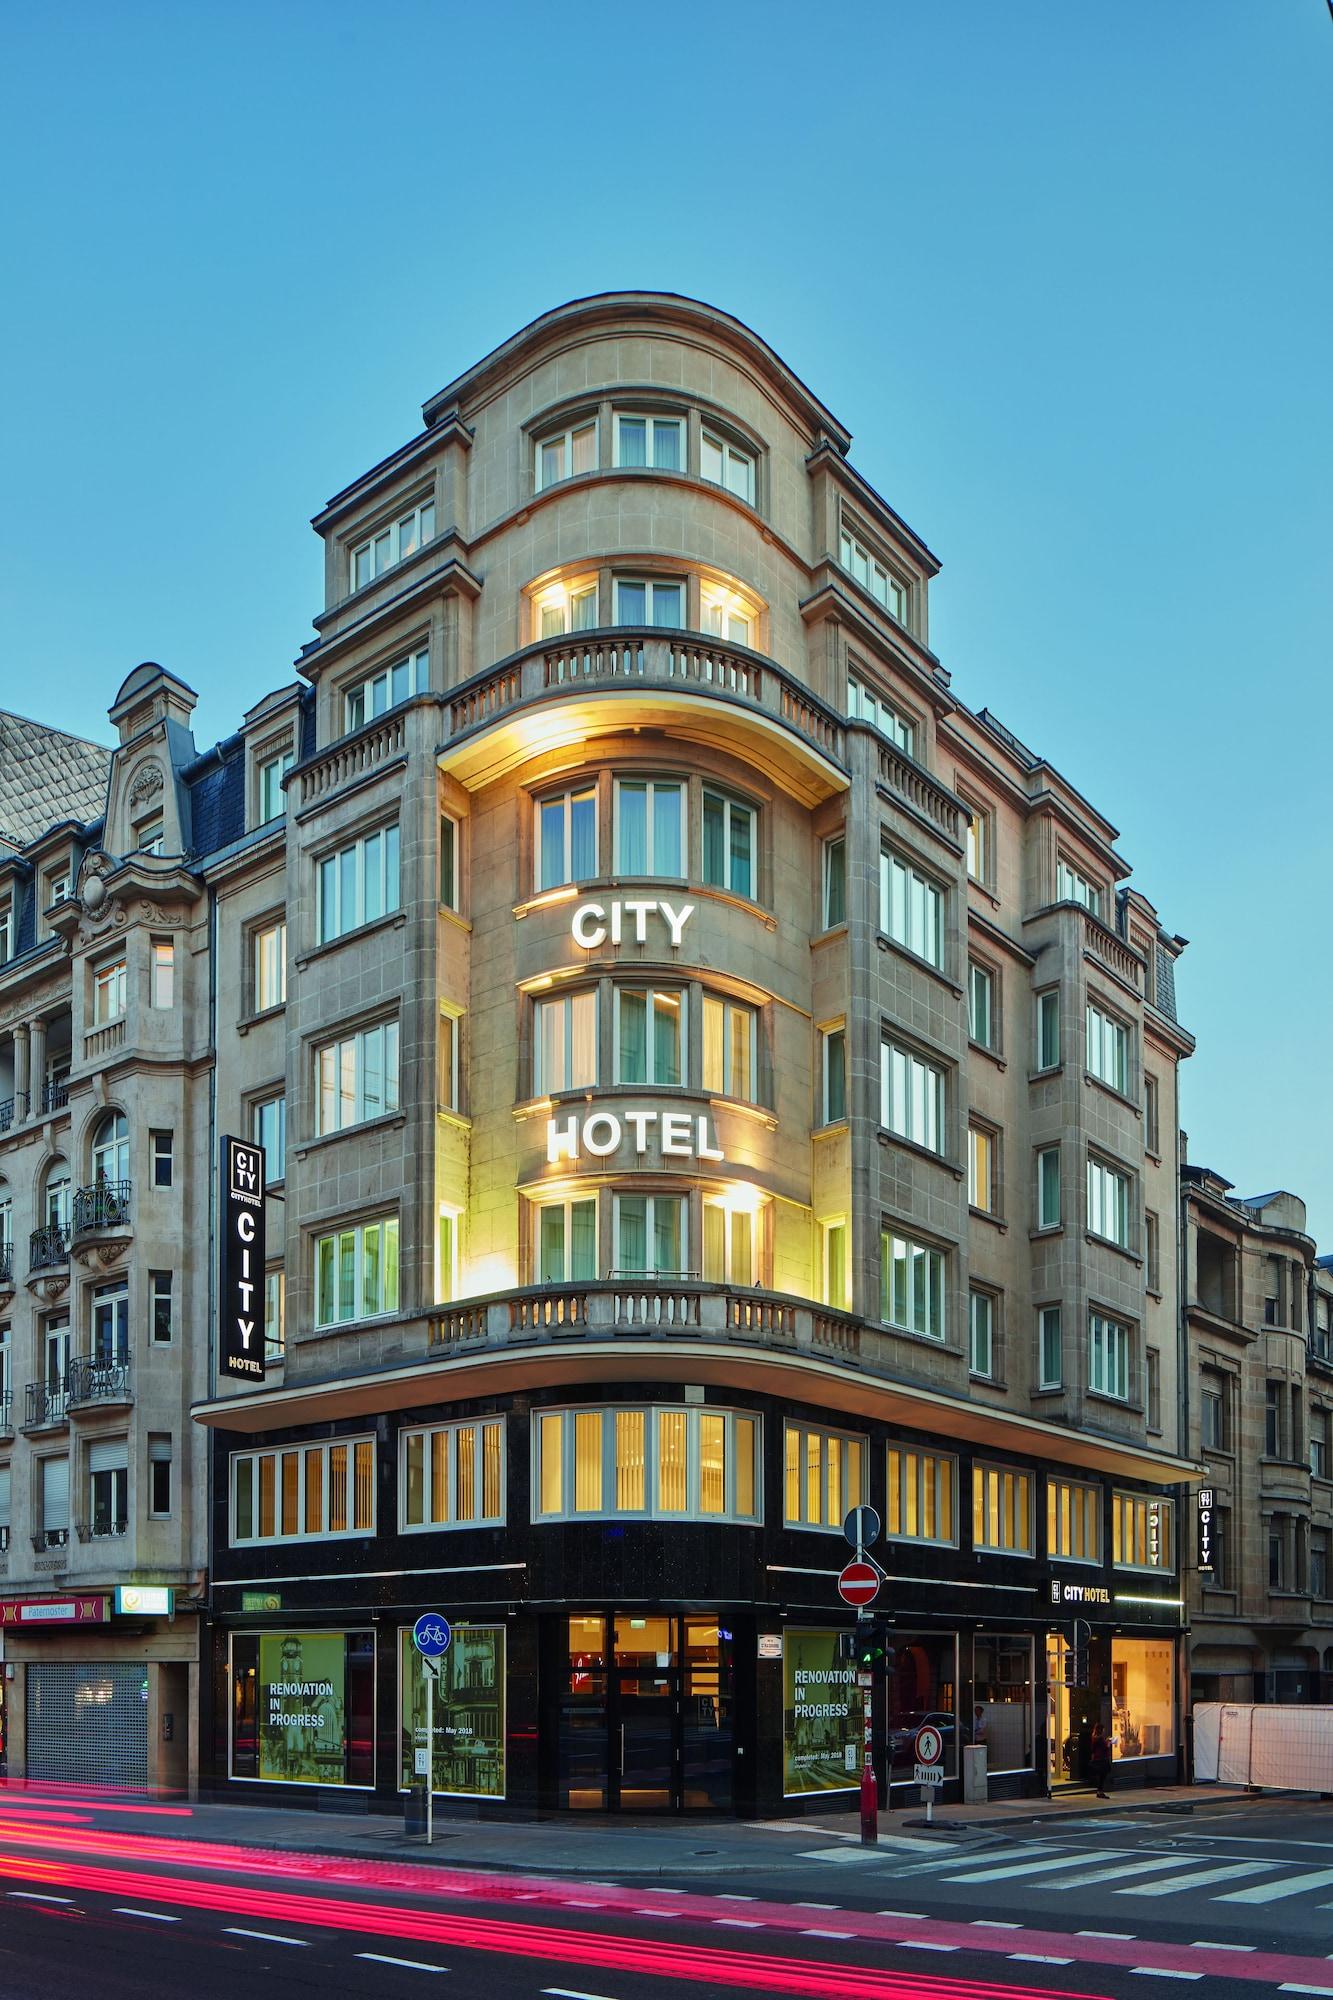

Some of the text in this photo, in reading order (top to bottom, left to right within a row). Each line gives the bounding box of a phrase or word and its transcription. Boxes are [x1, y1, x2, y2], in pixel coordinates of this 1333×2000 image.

[571, 901, 694, 949] CITY
[547, 1111, 724, 1162] HOTEL
[237, 1211, 255, 1349] CITY
[228, 1356, 263, 1373] HOTEL
[1201, 1510, 1210, 1563] CITY
[28, 1606, 69, 1617] Paternoster
[795, 1670, 856, 1684] RENOVATION
[270, 1682, 333, 1696] RENOVATION
[795, 1687, 805, 1700] IN
[270, 1698, 280, 1710] IN
[795, 1703, 848, 1718] PROGRESS
[270, 1713, 325, 1727] PROGRESS
[445, 1727, 457, 1736] May
[458, 1727, 473, 1735] 2018
